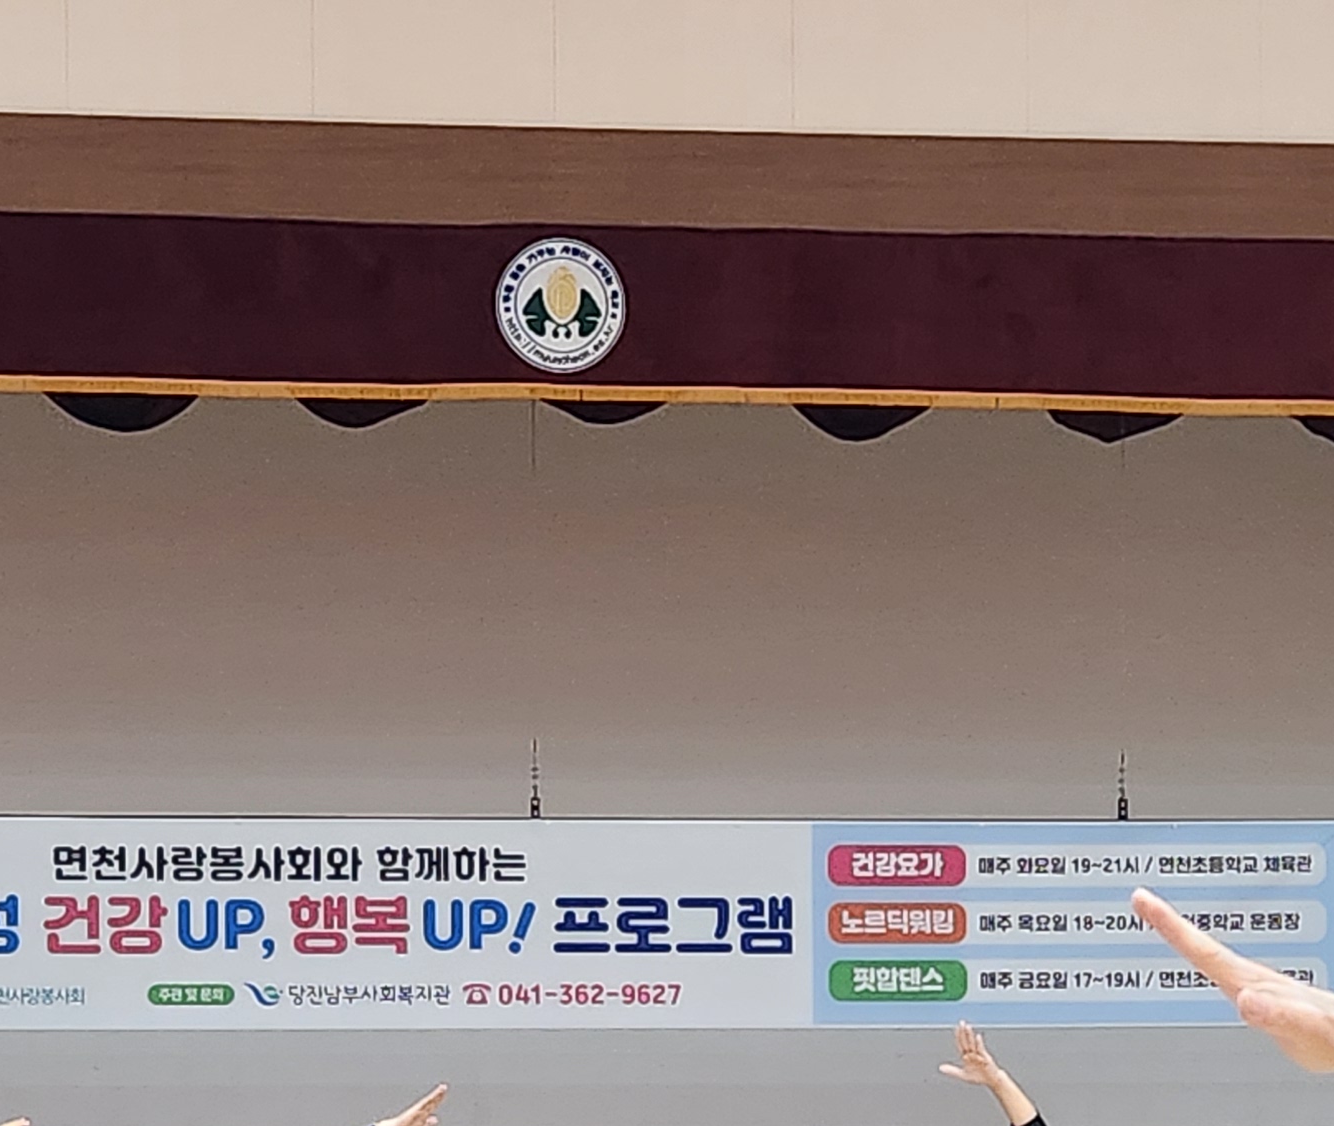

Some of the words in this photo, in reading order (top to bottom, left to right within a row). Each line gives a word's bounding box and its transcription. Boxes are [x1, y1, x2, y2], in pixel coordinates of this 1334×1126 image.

[53, 846, 362, 882] 면천사랑봉사회와
[377, 846, 526, 882] 함께하는
[852, 852, 944, 878] 건강요가
[978, 857, 1011, 875] 매주
[1017, 856, 1066, 875] 화요일
[1071, 856, 1139, 875] 19~21시
[1159, 856, 1258, 874] 면천초등학교
[1264, 855, 1312, 874] 체육관
[553, 896, 794, 954] 프로그램
[841, 908, 955, 935] 노르딕워킹
[979, 915, 1012, 932] 매주
[1018, 915, 1067, 931] 목요일
[1074, 914, 1144, 931] 18~20시
[1181, 914, 1244, 931] 중학교
[1250, 913, 1300, 931] 운동장
[980, 971, 1013, 989] 매주
[1019, 972, 1068, 989] 금요일
[1074, 971, 1140, 989] 17~19시
[288, 985, 450, 1005] 당진남부사회복지관
[498, 984, 682, 1005] 041-362-9627
